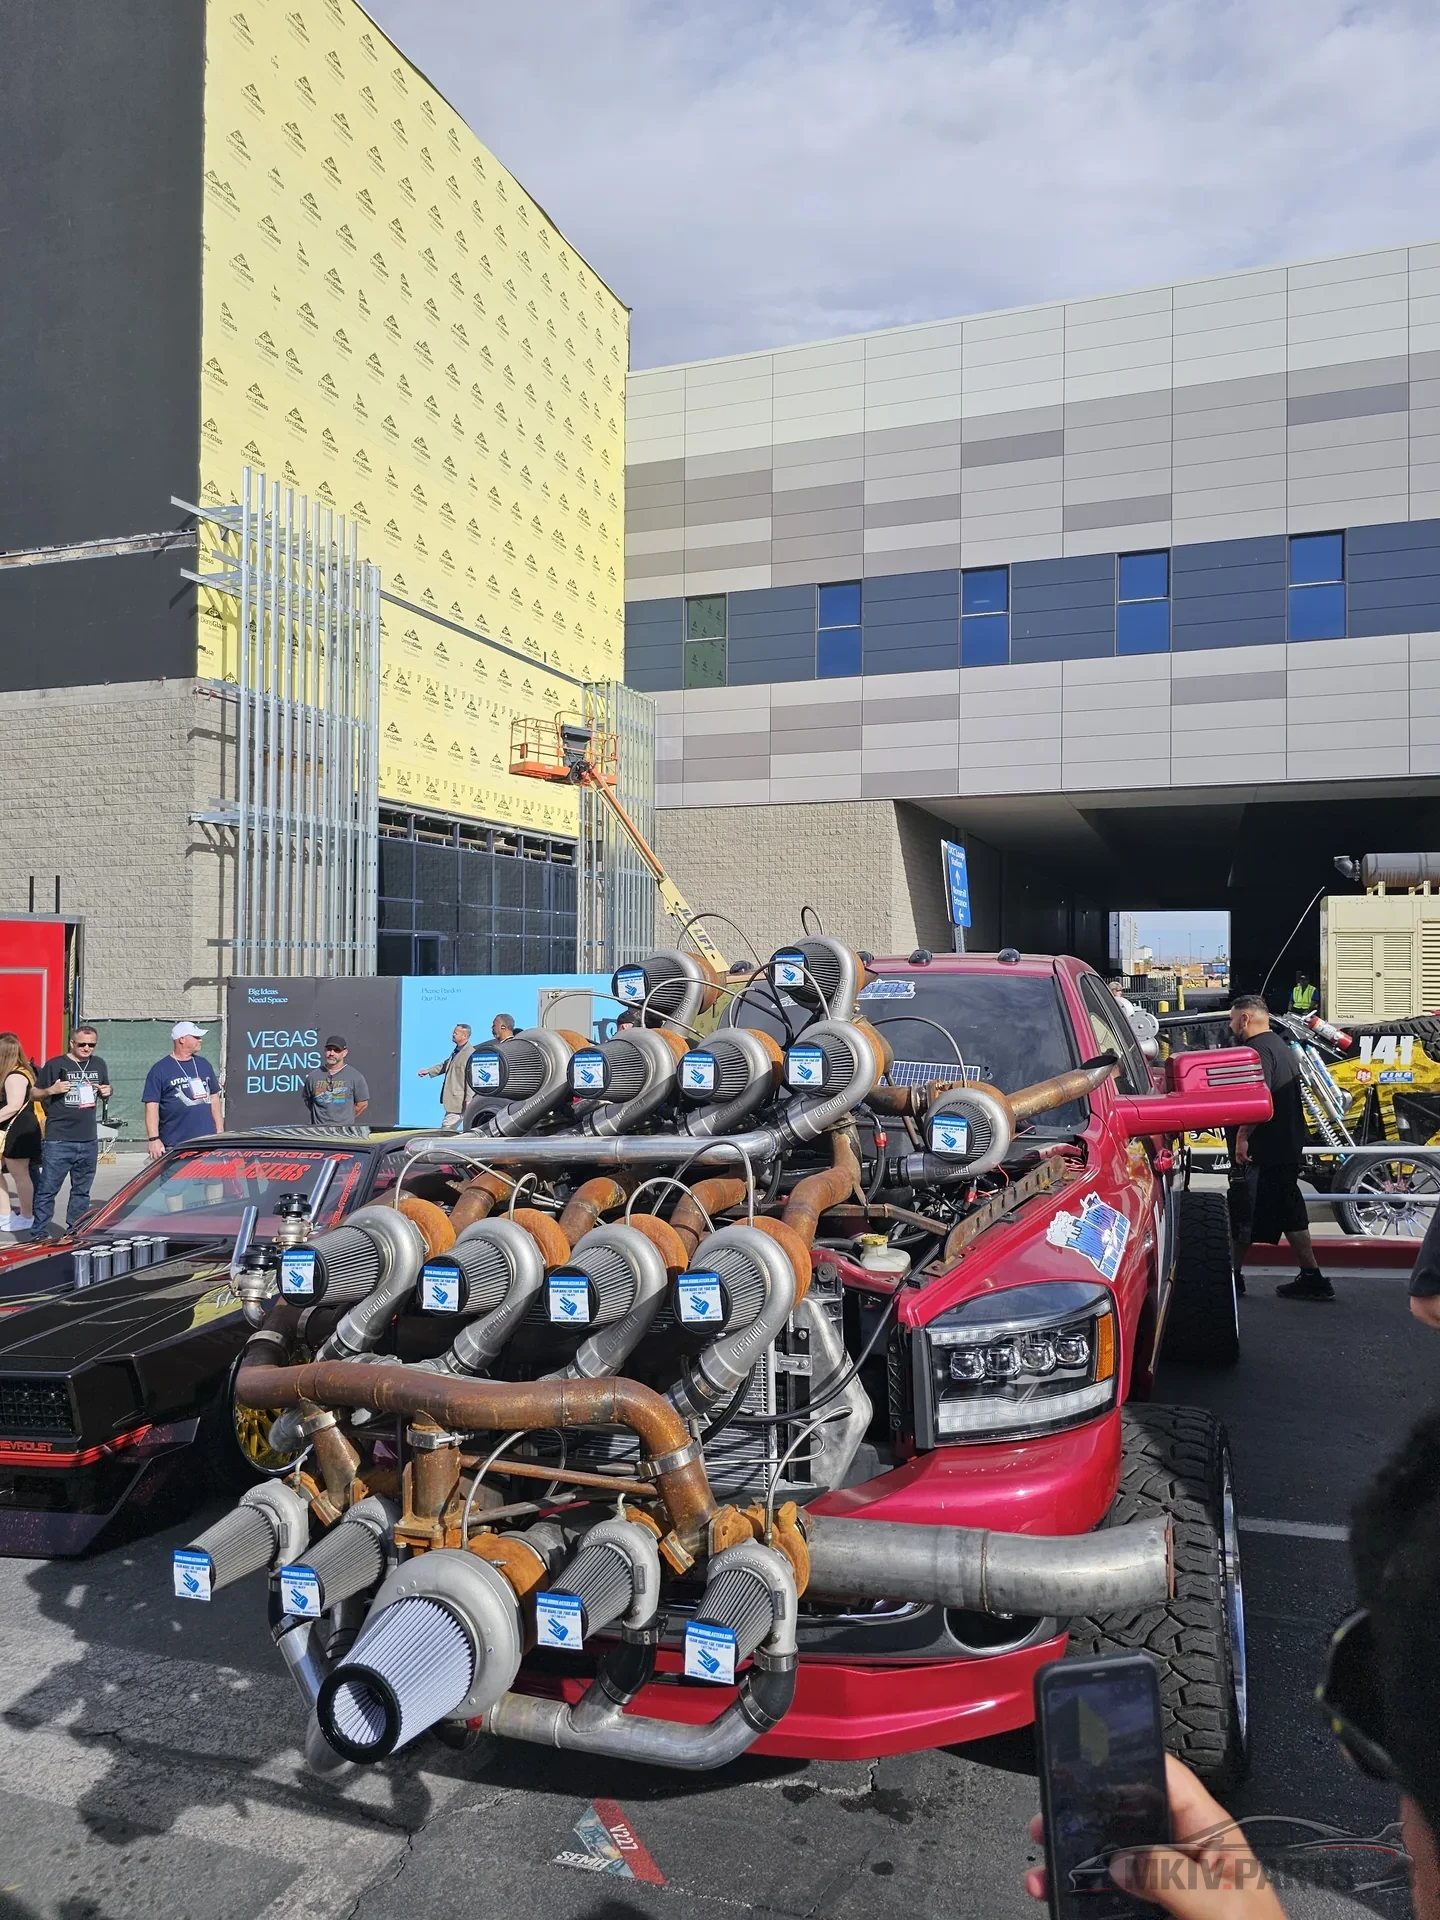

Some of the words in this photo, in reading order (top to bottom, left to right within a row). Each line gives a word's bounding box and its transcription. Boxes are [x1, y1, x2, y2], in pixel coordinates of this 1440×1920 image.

[229, 260, 254, 282] DensGlass
[370, 258, 389, 278] DensGlass
[324, 275, 345, 294] DensGlass
[297, 310, 318, 329] DensGlass
[255, 339, 279, 358] DensGlass
[333, 336, 352, 354] DensGlass
[202, 366, 228, 386] DensGlass
[318, 381, 339, 398] DensGlass
[245, 392, 268, 410] DensGlass
[285, 415, 307, 434] DensGlass
[241, 450, 265, 468] DensGlass
[352, 457, 372, 472] DensGlass
[315, 490, 336, 506] DensGlass
[201, 616, 227, 631] DensGlass
[951, 857, 963, 868] Station
[956, 849, 965, 861] Loop
[953, 896, 967, 907] Entrance
[694, 923, 716, 951] LIFT
[247, 1030, 318, 1048] VEGAS
[1360, 1036, 1414, 1065] 141
[247, 1052, 321, 1071] MEANS
[195, 1151, 324, 1159] AMANIFORGED
[610, 1823, 638, 1850] V227
[556, 1851, 612, 1868] SEMA
